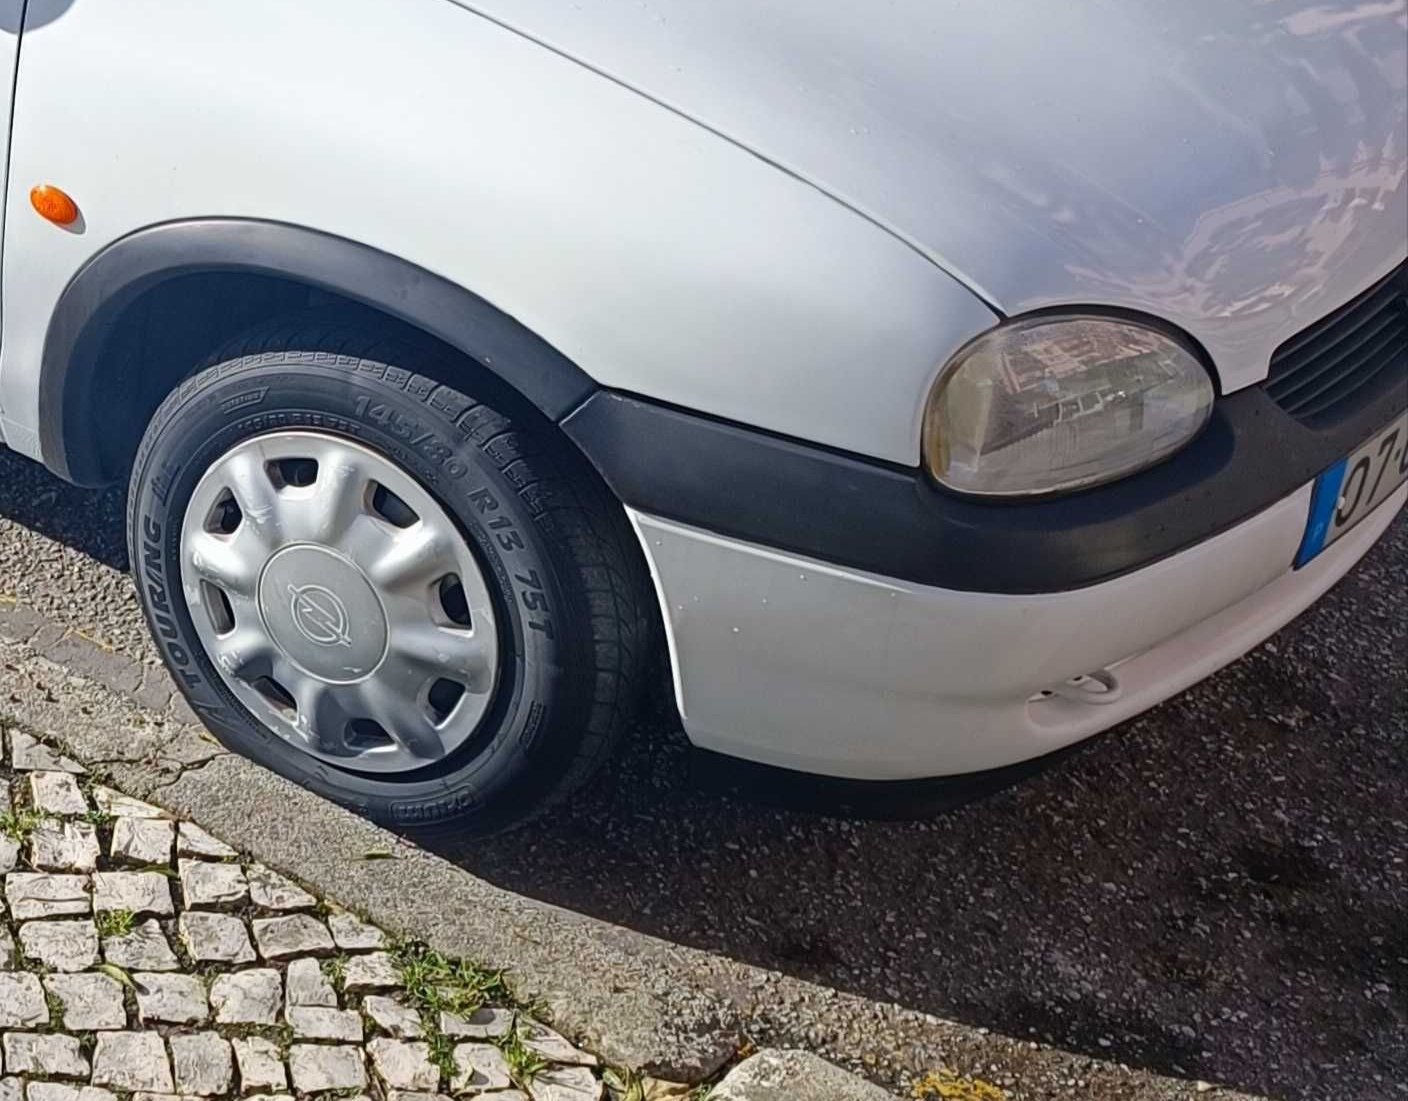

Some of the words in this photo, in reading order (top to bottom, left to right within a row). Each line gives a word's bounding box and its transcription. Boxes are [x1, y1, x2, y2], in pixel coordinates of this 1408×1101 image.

[144, 514, 202, 689] TOURING
[354, 396, 469, 481] 145/80
[466, 487, 526, 553] R13
[514, 567, 555, 641] 75T
